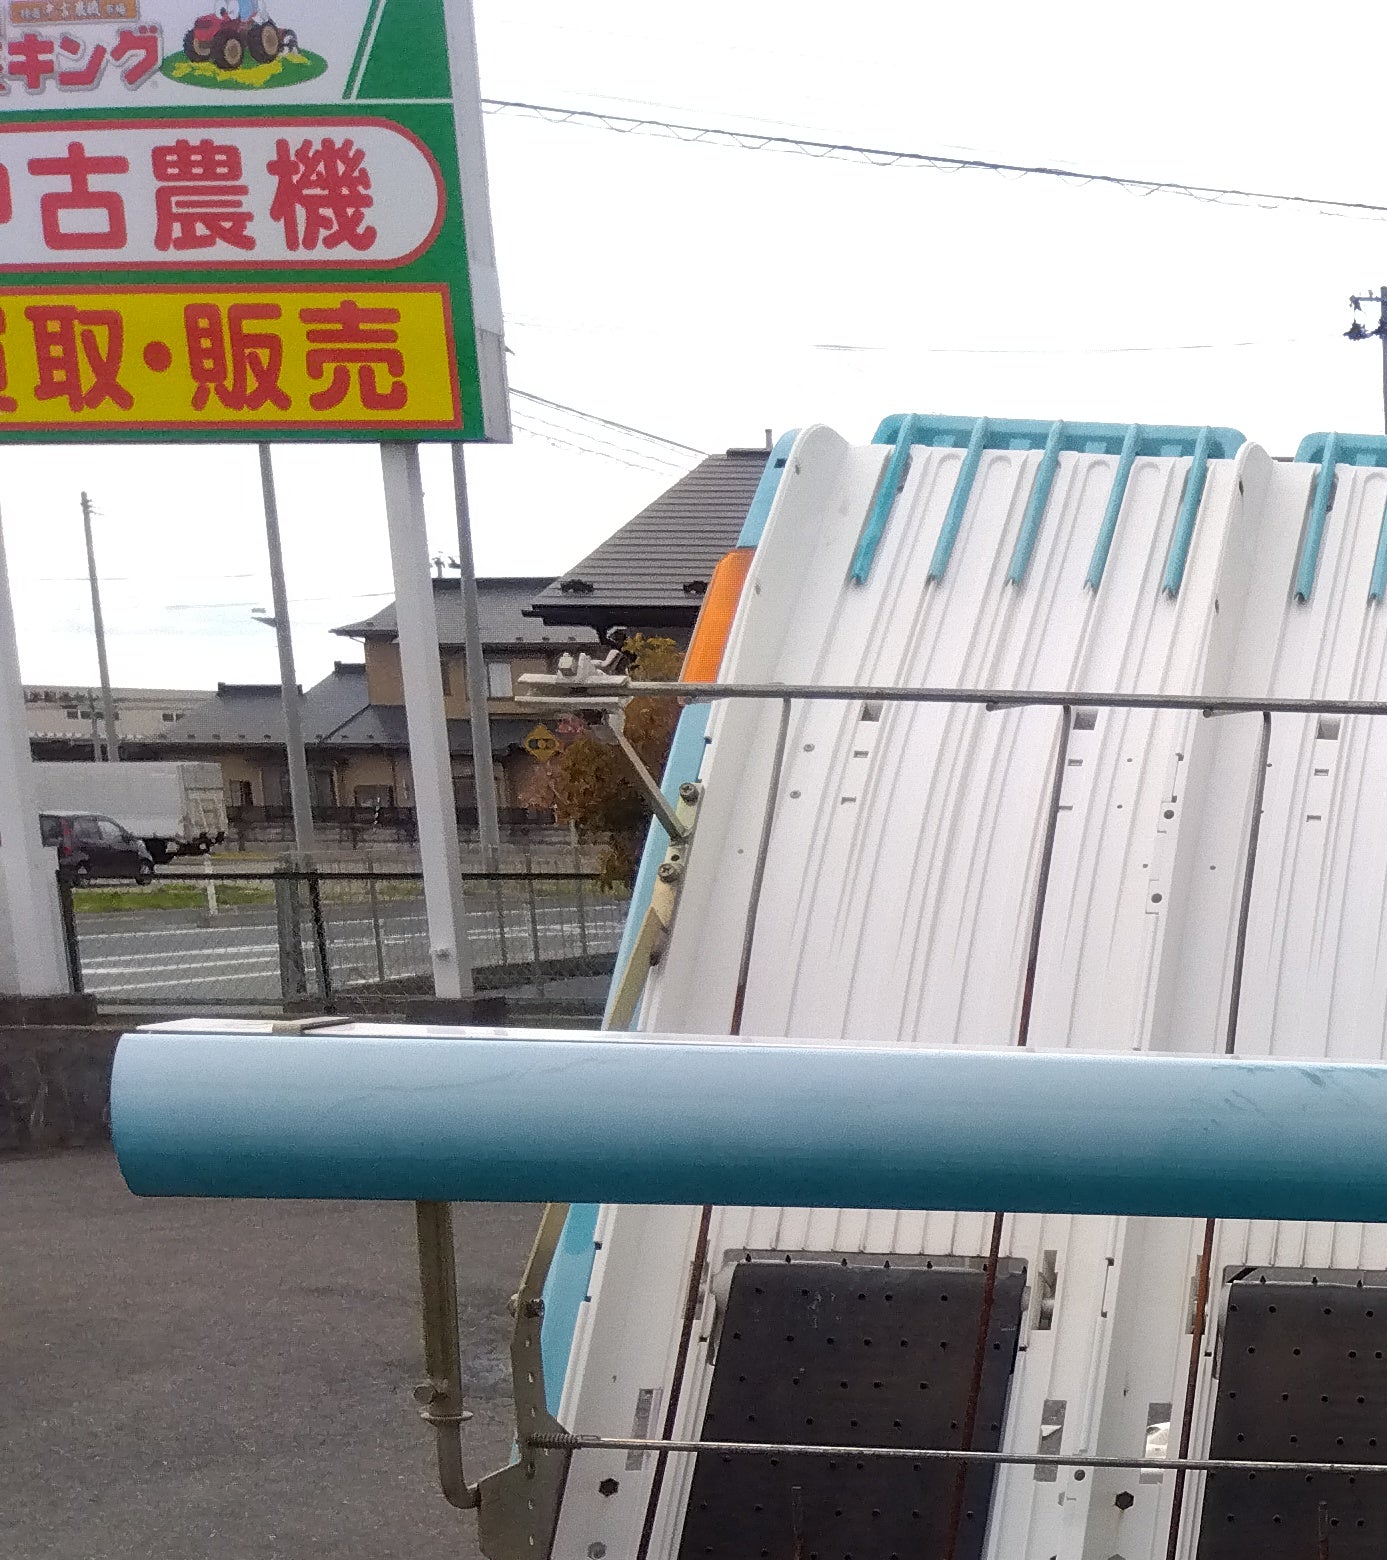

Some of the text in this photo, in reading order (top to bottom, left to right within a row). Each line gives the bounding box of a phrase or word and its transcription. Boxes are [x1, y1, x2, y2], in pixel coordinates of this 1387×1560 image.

[0, 24, 159, 90] キング
[0, 138, 378, 252] 古農機
[0, 299, 409, 413] 取・販売
